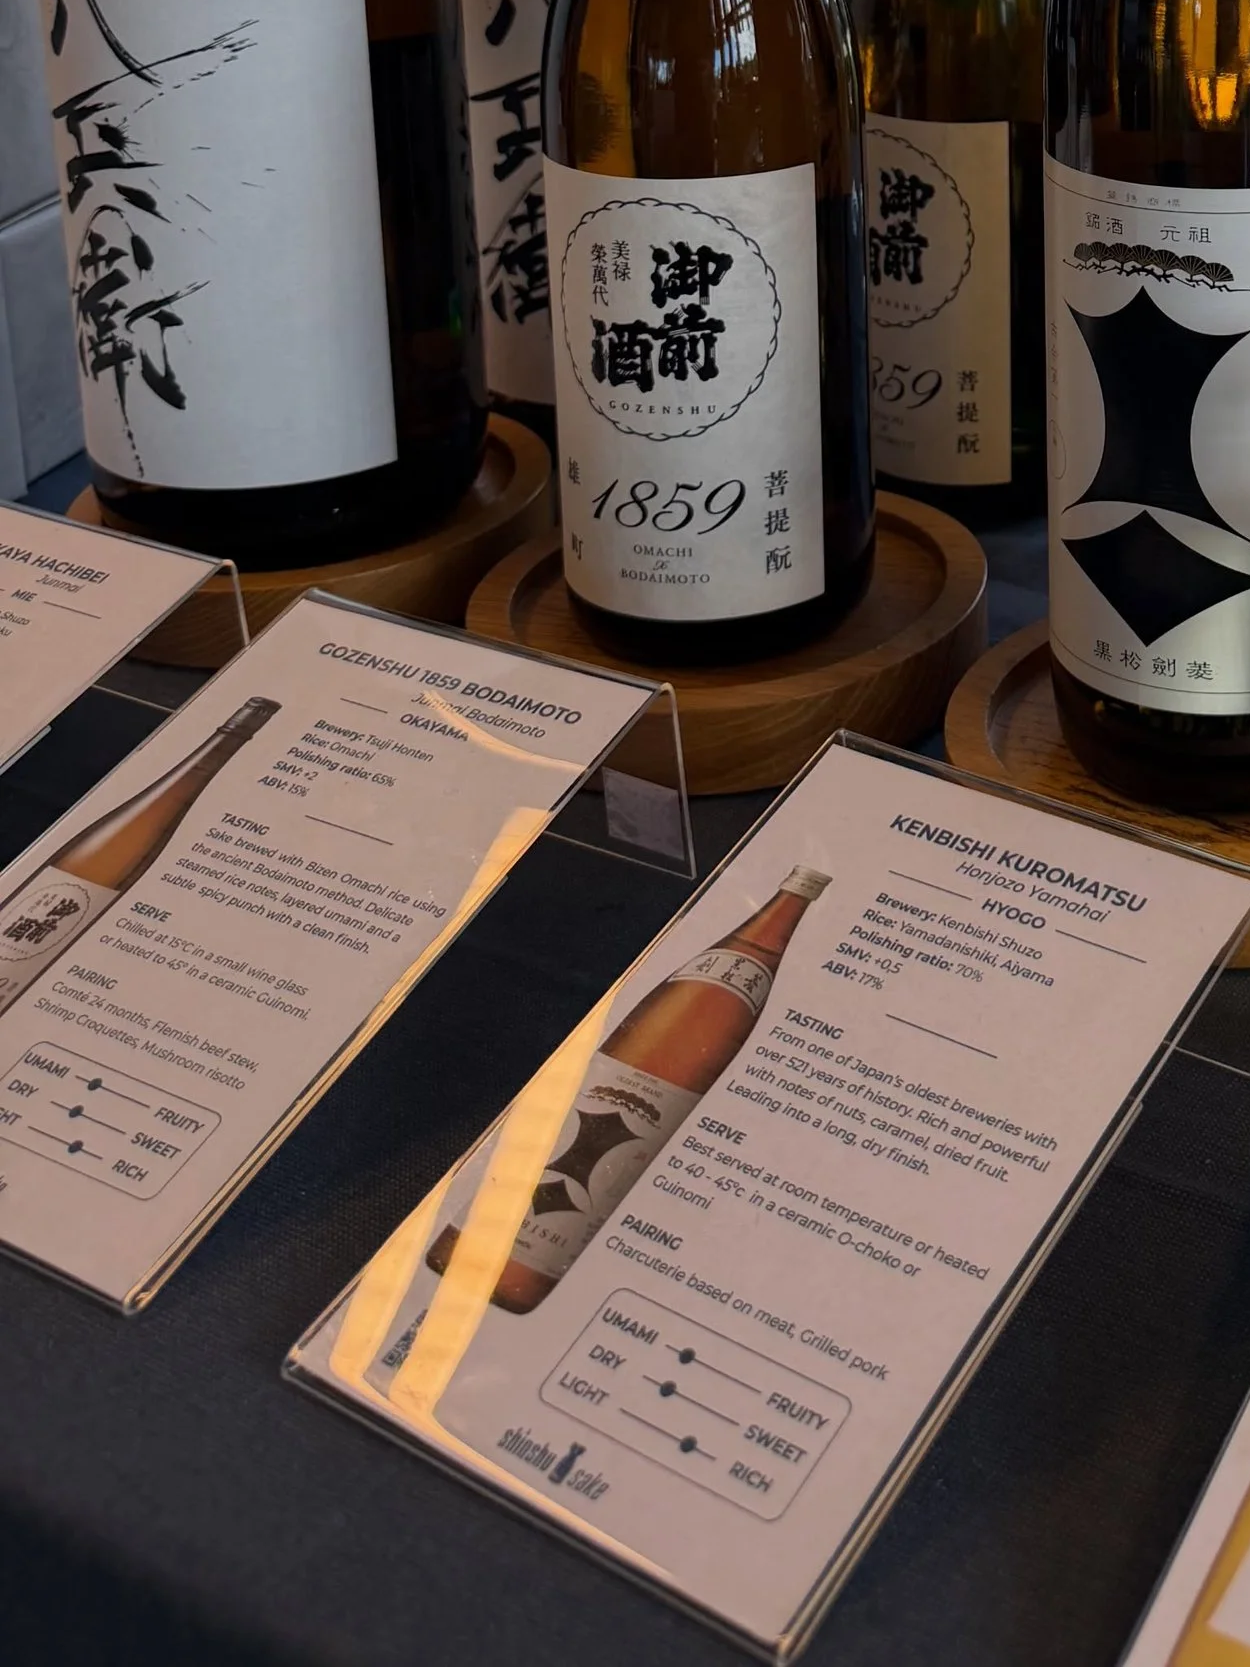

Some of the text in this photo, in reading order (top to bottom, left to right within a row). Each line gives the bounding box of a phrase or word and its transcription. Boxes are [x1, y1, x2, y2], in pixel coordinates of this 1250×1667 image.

[609, 400, 717, 415] GOZENSHU
[592, 478, 747, 535] 1859
[633, 543, 694, 558] OMACHI
[35, 554, 111, 585] HACHIBEI
[620, 567, 712, 586] BODAIMOTO
[11, 588, 38, 603] MIE
[319, 642, 583, 725] GOZENSHU 1859 BODAIMOTO
[399, 713, 469, 743] OKAYAMA
[466, 708, 546, 739] Bodaimoto
[300, 732, 377, 762] Rice: Omachi
[313, 719, 434, 763] Brewery: Tsuji Honten
[272, 760, 304, 777] SMV:
[286, 746, 397, 788] Polishing ratio: 65%
[256, 774, 310, 798] ABV: 15%
[220, 812, 271, 837] TASTING
[889, 814, 1148, 912] KENBISHI KUROMATSU
[955, 860, 1112, 923] Honjozo Yamahai
[129, 901, 173, 923] SERVE
[875, 892, 1043, 961] Brewery: Kenbishi Shuzo
[981, 897, 1047, 930] HYOGO
[835, 942, 904, 975] SMV: +0,5
[848, 924, 984, 983] Polishing ratio: 70%
[862, 908, 1055, 987] Rice: Yamadanishiki, Aiyama
[66, 964, 119, 990] PAIRING
[820, 959, 885, 991] ABV: 17%
[784, 1007, 845, 1041] TASTING
[23, 1051, 71, 1079] UMAMI
[6, 1078, 40, 1098] DRY
[768, 1025, 1058, 1152] From one of Japan's oldest breweries with
[153, 1106, 206, 1134] FRUITY
[755, 1045, 1051, 1173] over 521 years of history. Rich and powerful
[130, 1131, 182, 1159] SWEET
[696, 1116, 748, 1146] SERVE
[111, 1158, 150, 1183] RICH
[619, 1213, 684, 1251] PAIRING
[605, 1235, 890, 1381] Charcuterie based on meat, Grilled pork
[601, 1307, 660, 1345] UMAMI
[588, 1344, 627, 1370] DRY
[557, 1371, 610, 1406] LIGHT
[765, 1391, 830, 1431] FRUITY
[496, 1427, 558, 1473] shinshu
[743, 1424, 808, 1464] SWEET
[566, 1468, 611, 1502] sake
[728, 1460, 774, 1493] RICH
